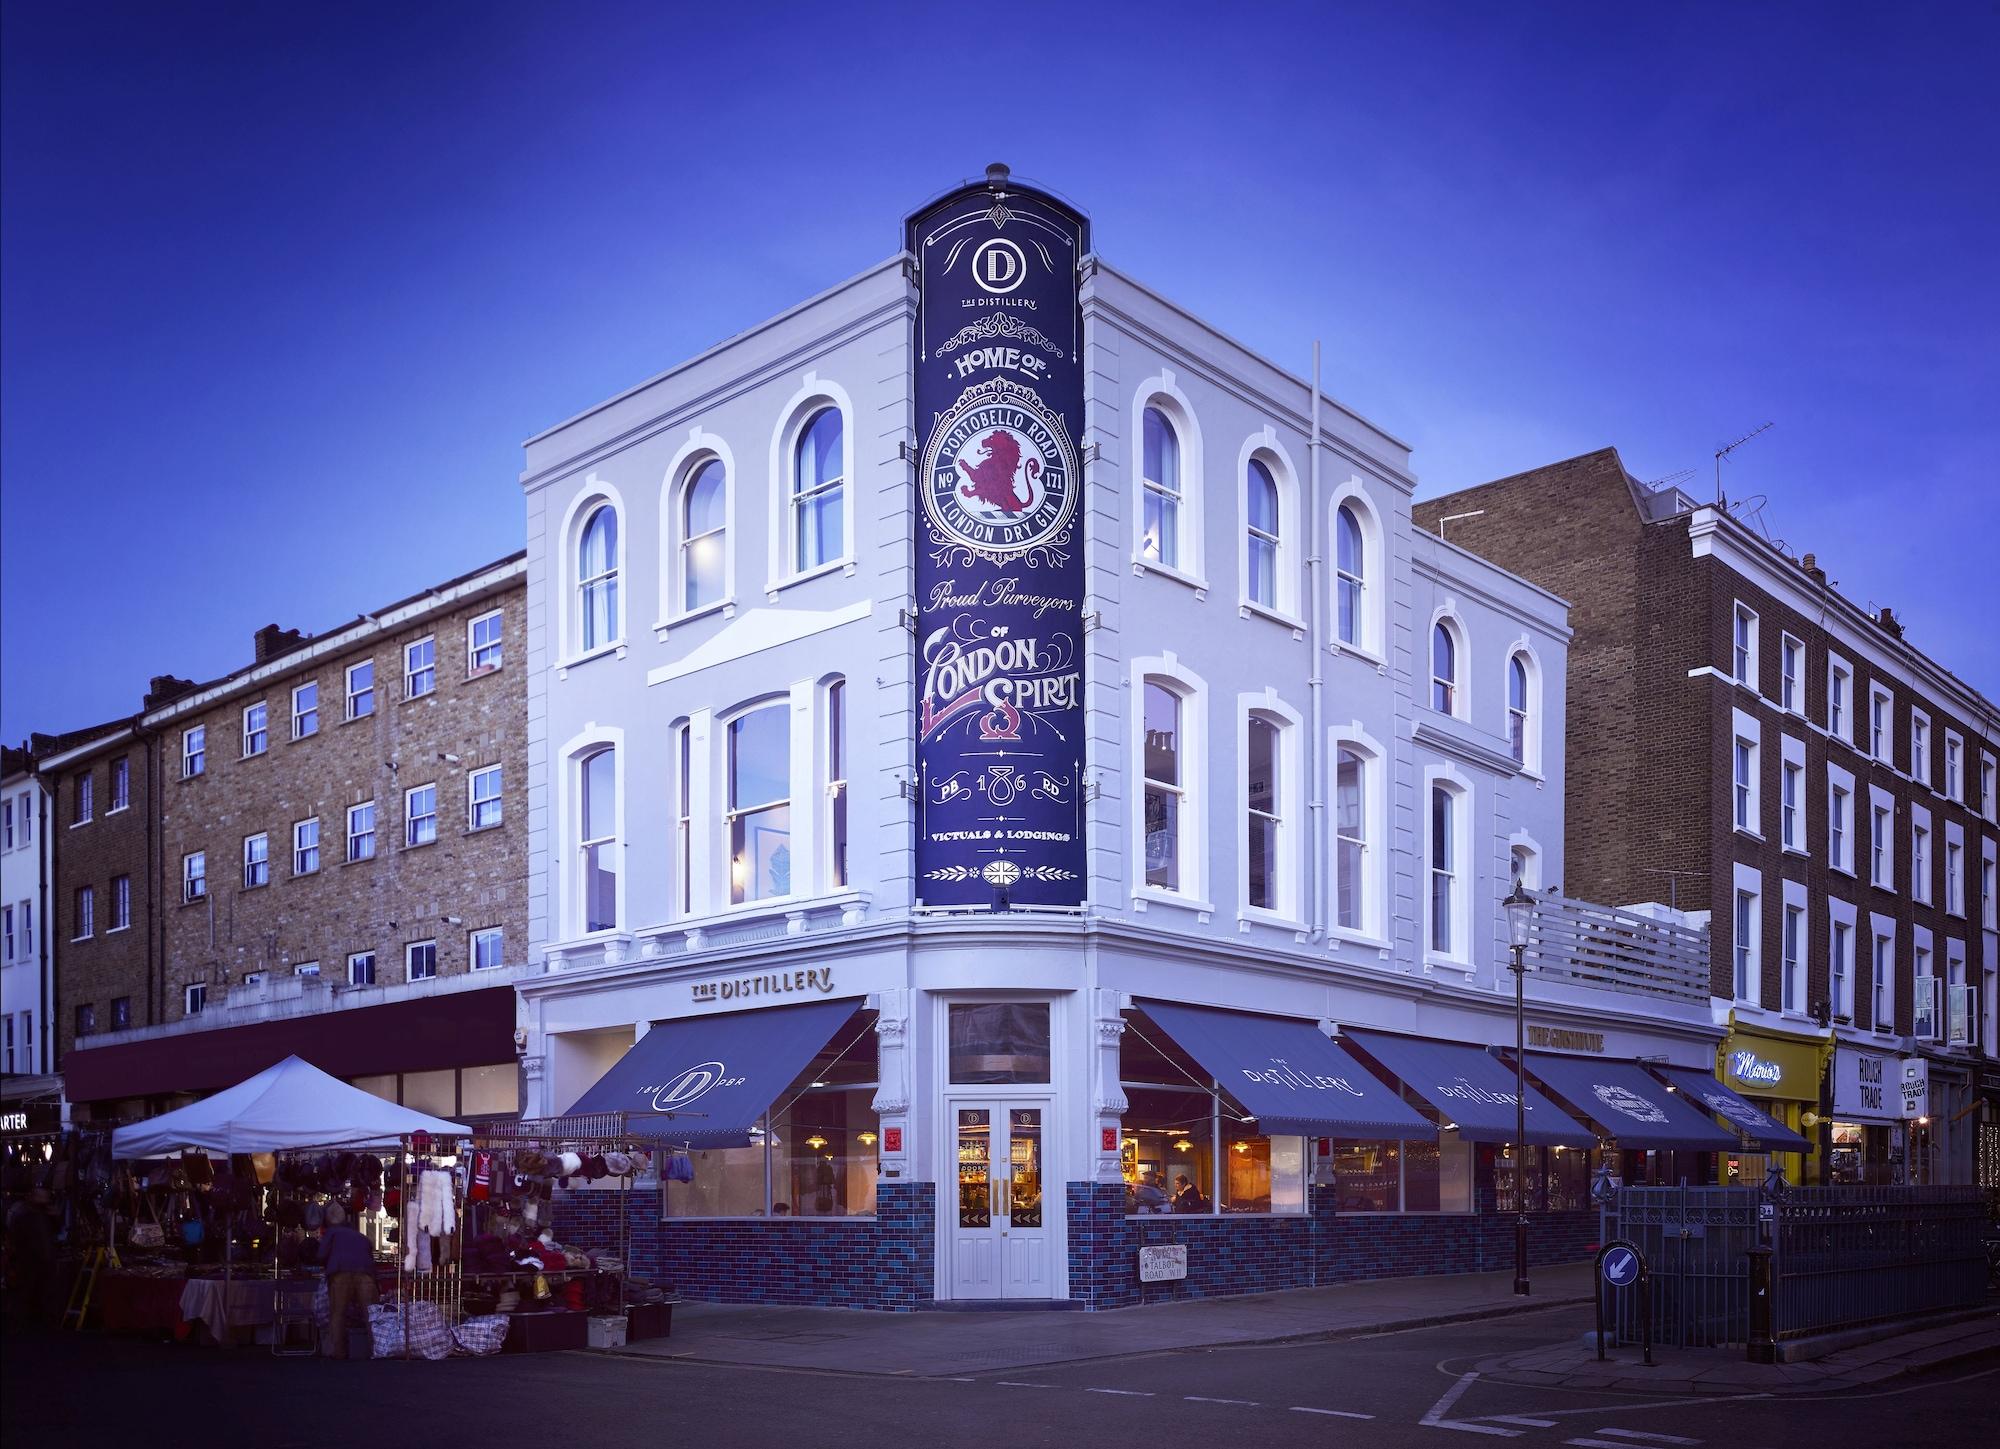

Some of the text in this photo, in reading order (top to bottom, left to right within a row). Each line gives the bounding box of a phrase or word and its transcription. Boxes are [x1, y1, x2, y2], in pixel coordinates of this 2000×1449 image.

[986, 250, 1016, 281] D
[961, 298, 1038, 311] THE DISTILLERY
[954, 347, 1047, 381] HOME OF
[942, 410, 1058, 459] PORTOBELLO ROAD
[1046, 472, 1062, 490] 171
[942, 500, 1059, 543] LONDON DRY GIN
[923, 578, 1076, 619] Proud Purveyors
[991, 626, 1009, 637] OF
[920, 626, 1039, 744] LONDON
[980, 672, 1081, 740] SPIRIT
[941, 779, 960, 800] PB
[1042, 778, 1060, 796] RD
[931, 829, 1071, 842] VICTUALS & LODGINGS
[691, 967, 835, 1003] THE DISTILLERY
[716, 1077, 746, 1088] PBR
[1241, 1065, 1363, 1096] DISTILLERY
[1859, 1058, 1882, 1084] ROUGH
[1900, 1078, 1925, 1092] ROUGH
[662, 1071, 712, 1103] D
[1859, 1085, 1883, 1110] TRADE
